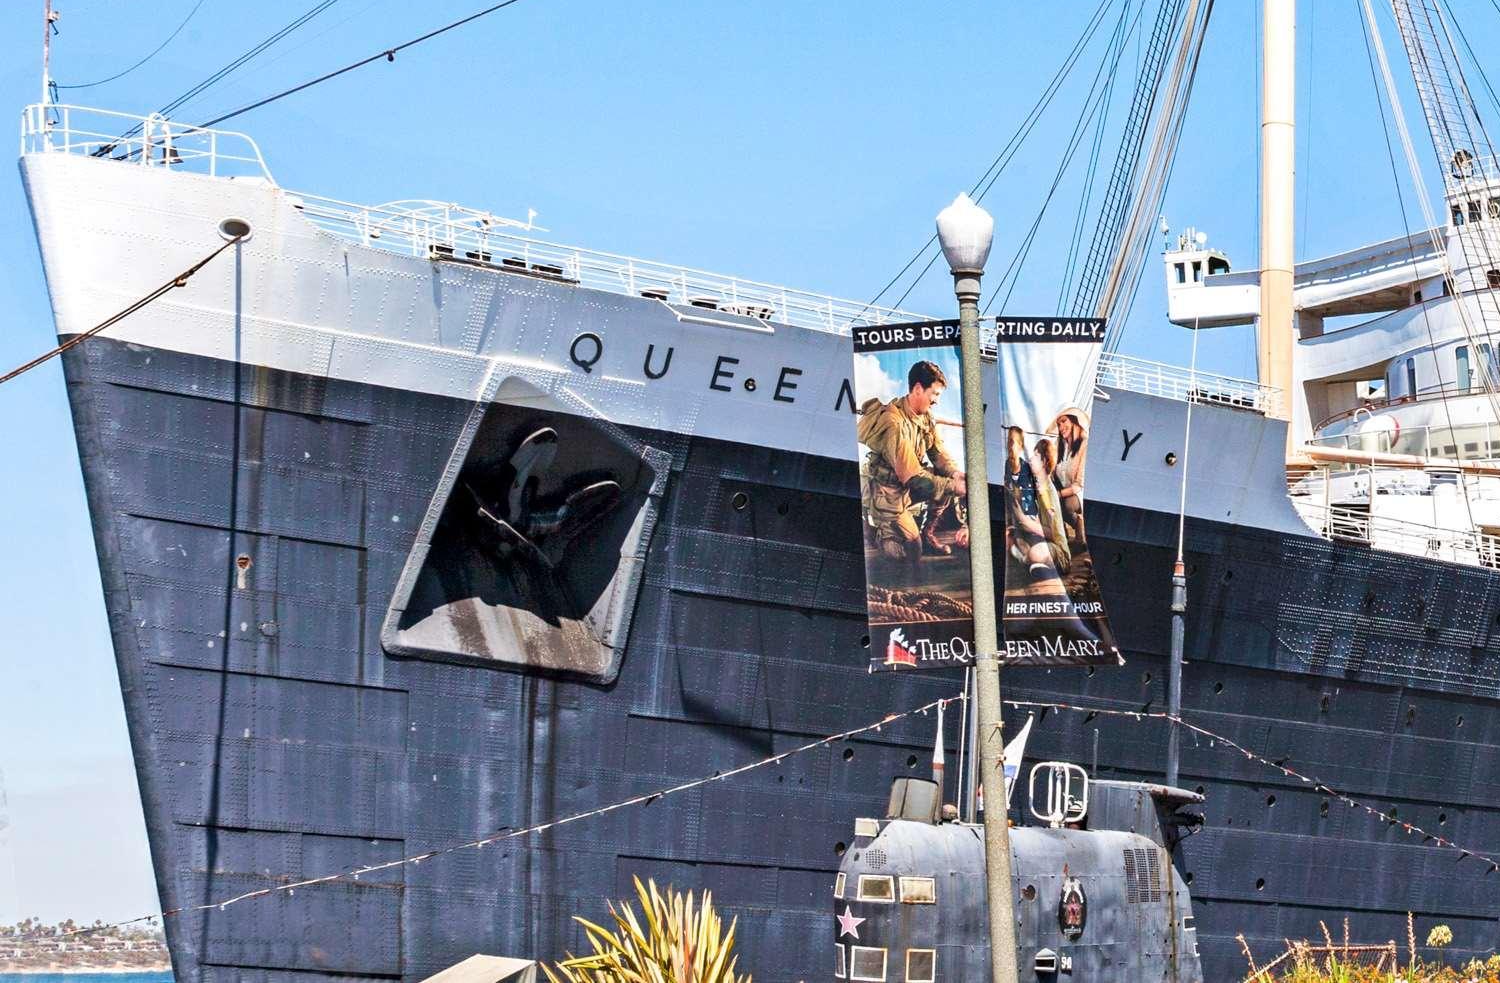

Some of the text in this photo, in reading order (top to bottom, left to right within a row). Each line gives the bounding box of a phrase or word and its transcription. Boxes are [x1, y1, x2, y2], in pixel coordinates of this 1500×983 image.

[858, 327, 914, 345] TOURS
[1006, 602, 1103, 614] HER FINEST HOUR
[915, 639, 950, 661] THE
